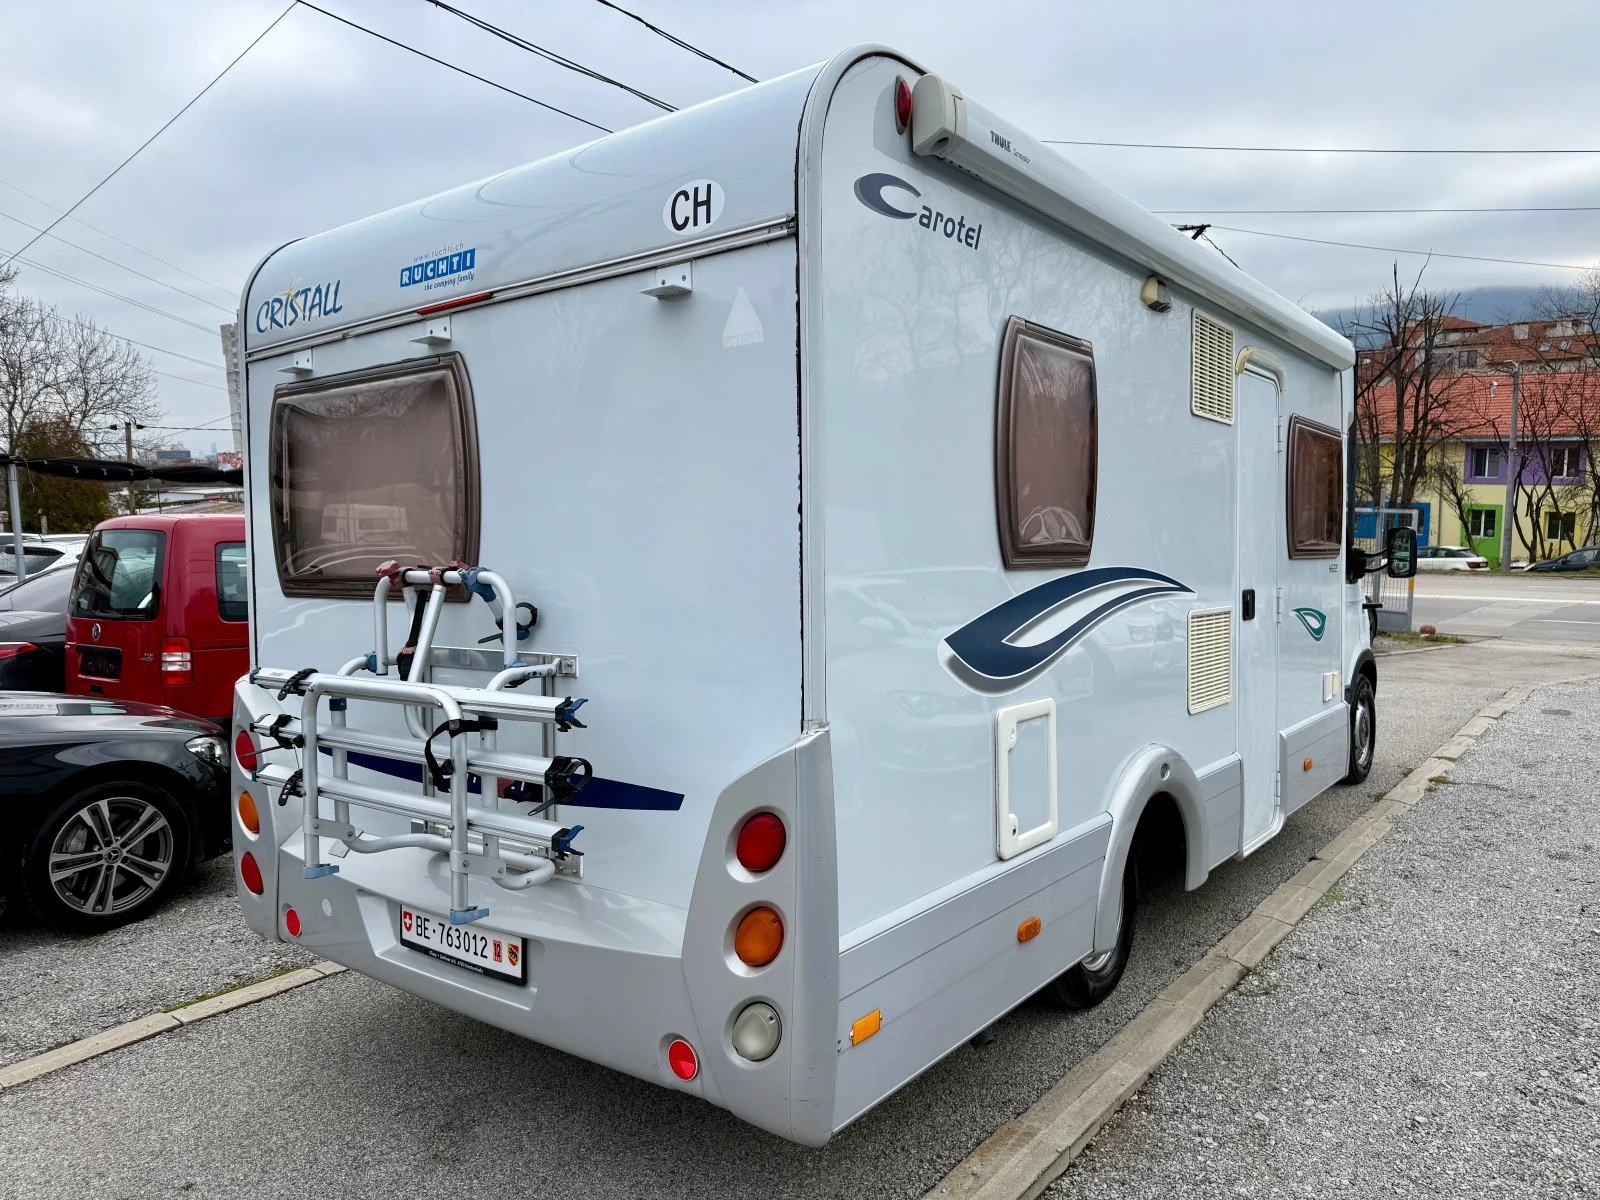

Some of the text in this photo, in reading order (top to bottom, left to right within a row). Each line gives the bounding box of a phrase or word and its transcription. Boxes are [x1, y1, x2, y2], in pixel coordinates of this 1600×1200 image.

[990, 130, 1011, 149] THULE
[670, 183, 712, 231] CH
[853, 172, 983, 250] Carotel
[401, 251, 472, 285] RUCHTI
[413, 240, 464, 263] www.ruchti.ch
[424, 271, 475, 291] the camping family
[256, 279, 343, 334] CRISTALL
